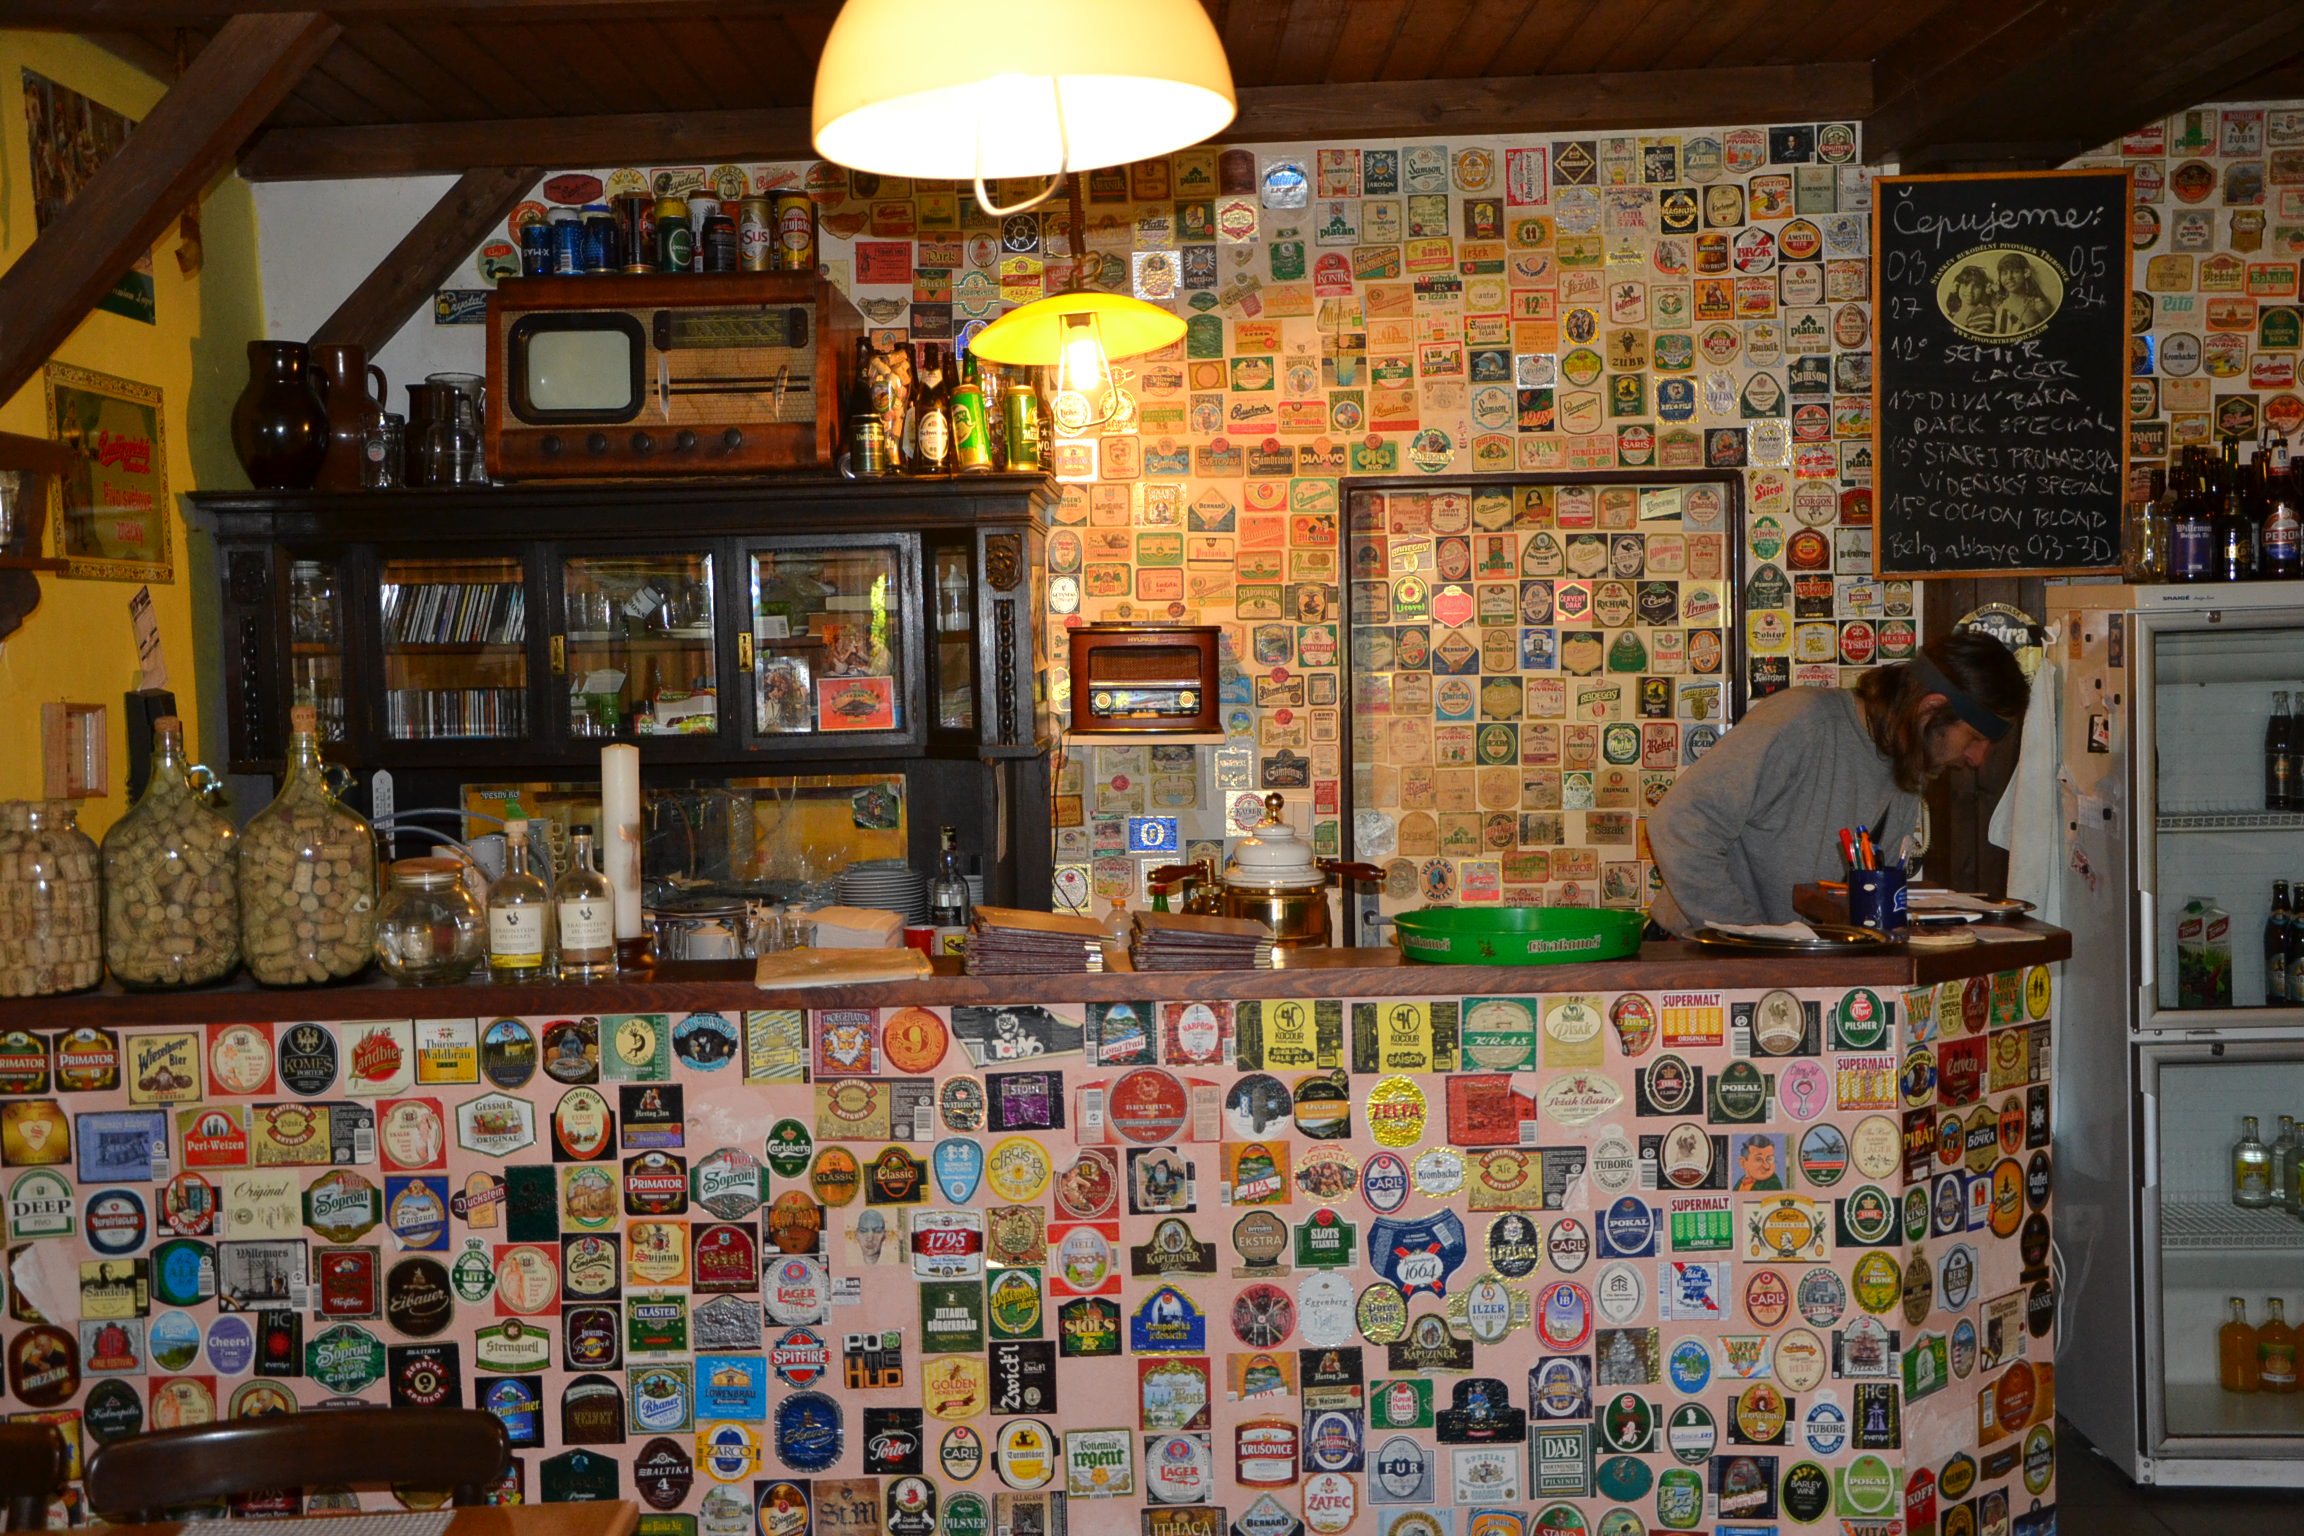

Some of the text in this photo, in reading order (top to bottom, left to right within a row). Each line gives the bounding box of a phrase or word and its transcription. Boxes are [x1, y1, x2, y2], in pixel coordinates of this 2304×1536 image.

[1408, 161, 1444, 180] Samson
[1180, 175, 1211, 186] platan
[1662, 207, 1696, 215] MAGNUM
[1894, 186, 2104, 248] Čepujeme:
[1319, 226, 1355, 237] platan
[926, 252, 956, 263] Park
[1737, 247, 1771, 258] BROK
[1888, 249, 1927, 286] 0,3
[2069, 245, 2109, 286] 0,5
[2070, 286, 2107, 309] 34
[1891, 296, 1923, 320] 27
[1791, 325, 1825, 337] platan
[1709, 338, 1731, 347] AMBER
[1611, 356, 1645, 367] ZUBR
[2164, 352, 2197, 360] Krombacher
[1790, 370, 1828, 383] Samson
[1972, 361, 2080, 383] LAGER
[1478, 400, 1508, 417] Samson
[1522, 411, 1551, 425] 1998
[1914, 414, 1984, 434] DARK
[1755, 484, 1784, 500] Stiegl
[1929, 500, 2022, 529] COCHON
[2033, 508, 2107, 530] BLOND
[1559, 594, 1586, 603] ČERVENÝ
[1682, 600, 1721, 618] Premium
[1841, 638, 1875, 649] TYSKIE
[1662, 993, 1721, 1007] SUPERMALT
[1941, 1008, 1960, 1018] STOUT
[1183, 1023, 1215, 1033] HARPOON
[1845, 1021, 1878, 1031] PILSNER
[1275, 1032, 1304, 1040] KOCOUR
[1390, 1034, 1420, 1044] KOCOUR
[1473, 1036, 1530, 1047] KRAS
[424, 1039, 469, 1050] Thüringer
[653, 1016, 665, 1081] VERMONT
[59, 1053, 114, 1066] PRIMATOR
[169, 1054, 187, 1066] Bier
[422, 1050, 471, 1060] Waldbräu
[284, 1057, 334, 1074] KOMES
[1837, 1056, 1895, 1071] SUPERMALT
[1946, 1057, 1977, 1077] Cerveza
[1721, 1083, 1761, 1092] POKAL
[475, 1101, 514, 1111] GESSNER
[476, 1135, 519, 1144] ORIGINAL
[1904, 1127, 1935, 1149] PIRAT
[1967, 1130, 1996, 1148] БОЧКА
[187, 1140, 245, 1151] Perl-Weizen
[767, 1138, 812, 1154] Carlsberg
[1302, 1152, 1350, 1165] GOLIATH
[1496, 1163, 1512, 1174] Ale
[1594, 1160, 1633, 1170] TUBORG
[816, 1173, 854, 1184] CLASSIC
[877, 1166, 914, 1180] Classic
[1418, 1169, 1460, 1180] Krombacher
[629, 1179, 683, 1190] PRIMATOR
[703, 1169, 755, 1192] Soproni
[234, 1179, 287, 1199] Original
[314, 1191, 369, 1216] Soproni
[455, 1186, 505, 1213] Duckstein
[1671, 1199, 1730, 1212] SUPERMALT
[13, 1199, 72, 1217] DEEP
[1904, 1206, 1929, 1222] KING
[34, 1217, 52, 1227] PIVO
[400, 1212, 435, 1226] Torgauer
[1609, 1219, 1649, 1227] POKAL
[927, 1231, 968, 1248] 1795
[1311, 1228, 1340, 1239] SLOTS
[1239, 1236, 1282, 1247] EKSTRA
[1311, 1240, 1339, 1249] PILSNER
[235, 1247, 289, 1259] Willemoes
[1146, 1252, 1201, 1264] KAPUZINER
[463, 1271, 485, 1281] LITE
[1404, 1264, 1437, 1280] 1664
[1806, 1271, 1839, 1282] SPECIAL
[84, 1285, 130, 1298] Sandels
[777, 1287, 815, 1300] LAGER
[390, 1288, 449, 1312] Eibauer
[1305, 1297, 1348, 1308] Eggenberg
[1472, 1303, 1505, 1314] ILZER
[268, 1312, 291, 1328] HC
[209, 1336, 250, 1347] Cheers!
[486, 1339, 539, 1354] Sternquell
[316, 1342, 373, 1367] Soproni
[772, 1352, 828, 1364] SPITFIRE
[1403, 1348, 1457, 1359] KAPUZINER
[1404, 1348, 1458, 1360] KAPUZINER
[932, 1379, 977, 1389] GOLDEN
[1865, 1384, 1887, 1398] HC
[1807, 1424, 1845, 1434] TUBORG
[707, 1446, 751, 1456] ZARCO
[870, 1436, 911, 1461] Porter
[1544, 1437, 1579, 1459] DAB
[646, 1466, 690, 1477] BALTIKA
[1160, 1465, 1198, 1481] LAGER
[1384, 1462, 1418, 1474] FUR
[657, 1478, 670, 1490] 4
[1544, 1478, 1580, 1486] PILSENER
[1791, 1480, 1821, 1490] BARLEY
[1850, 1478, 1888, 1486] POKAL
[1797, 1488, 1816, 1496] WINE
[1907, 1484, 1935, 1506] KOFF
[1307, 1494, 1351, 1510] ŽATEC
[943, 1518, 987, 1529] PILSNER
[1153, 1522, 1212, 1536] ITHACA
